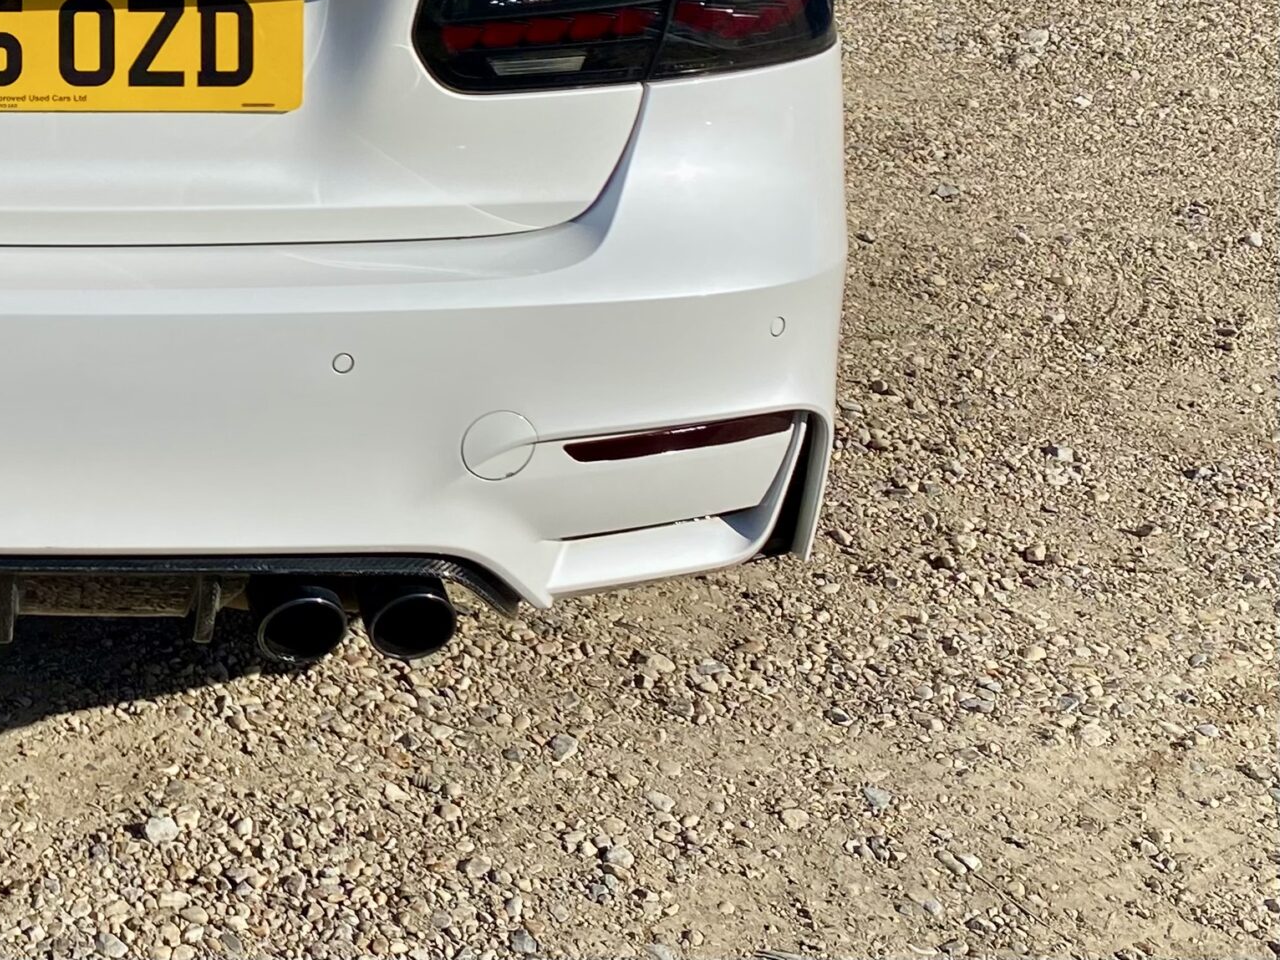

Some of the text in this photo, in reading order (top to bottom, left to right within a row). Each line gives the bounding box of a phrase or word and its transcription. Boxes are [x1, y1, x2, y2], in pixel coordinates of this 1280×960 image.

[28, 94, 50, 102] Used
[51, 94, 71, 102] Cars
[73, 94, 88, 102] Ltd
